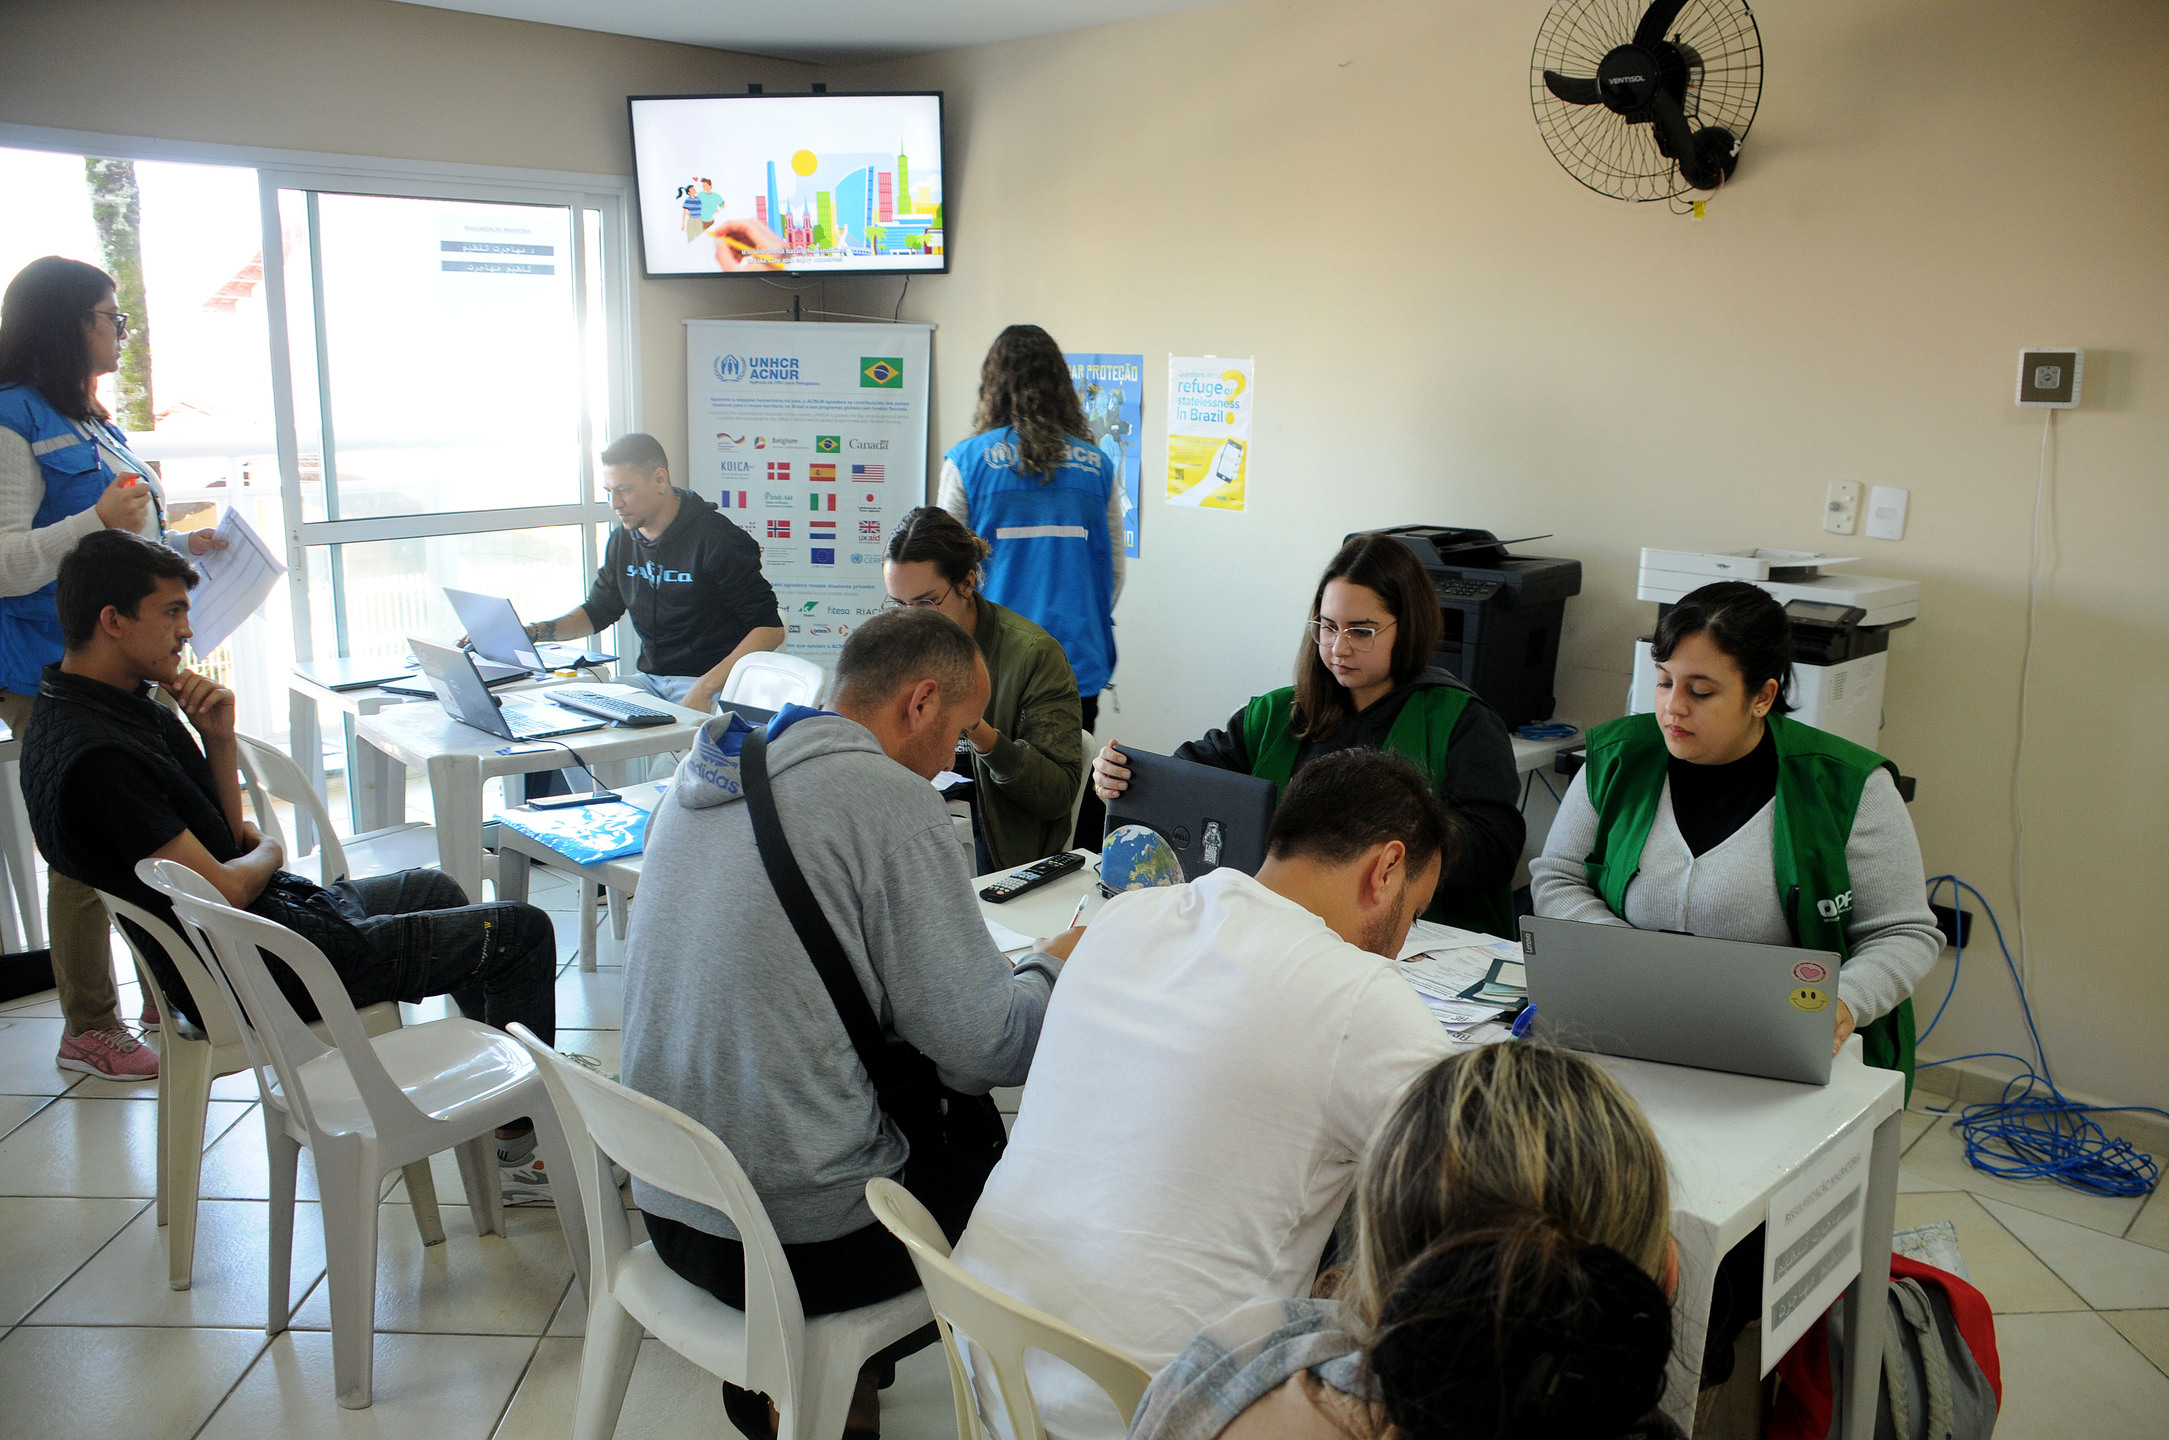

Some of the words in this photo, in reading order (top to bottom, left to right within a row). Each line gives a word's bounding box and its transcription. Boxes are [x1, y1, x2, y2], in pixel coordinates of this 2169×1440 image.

[1609, 75, 1646, 85] VENTISOL
[749, 357, 799, 368] UNHCR
[750, 369, 799, 379] ACNUR
[1087, 363, 1138, 385] PROTEÇÃO
[1178, 378, 1223, 398] refuge
[1177, 396, 1240, 409] statelessness
[1177, 407, 1187, 420] in
[1190, 408, 1223, 422] Brazil
[772, 437, 798, 445] Belgium
[849, 439, 889, 450] Canada
[1062, 444, 1101, 468] HCR
[721, 461, 750, 471] KOICA
[686, 760, 741, 794] adidas
[1525, 932, 1534, 954] Lenovo
